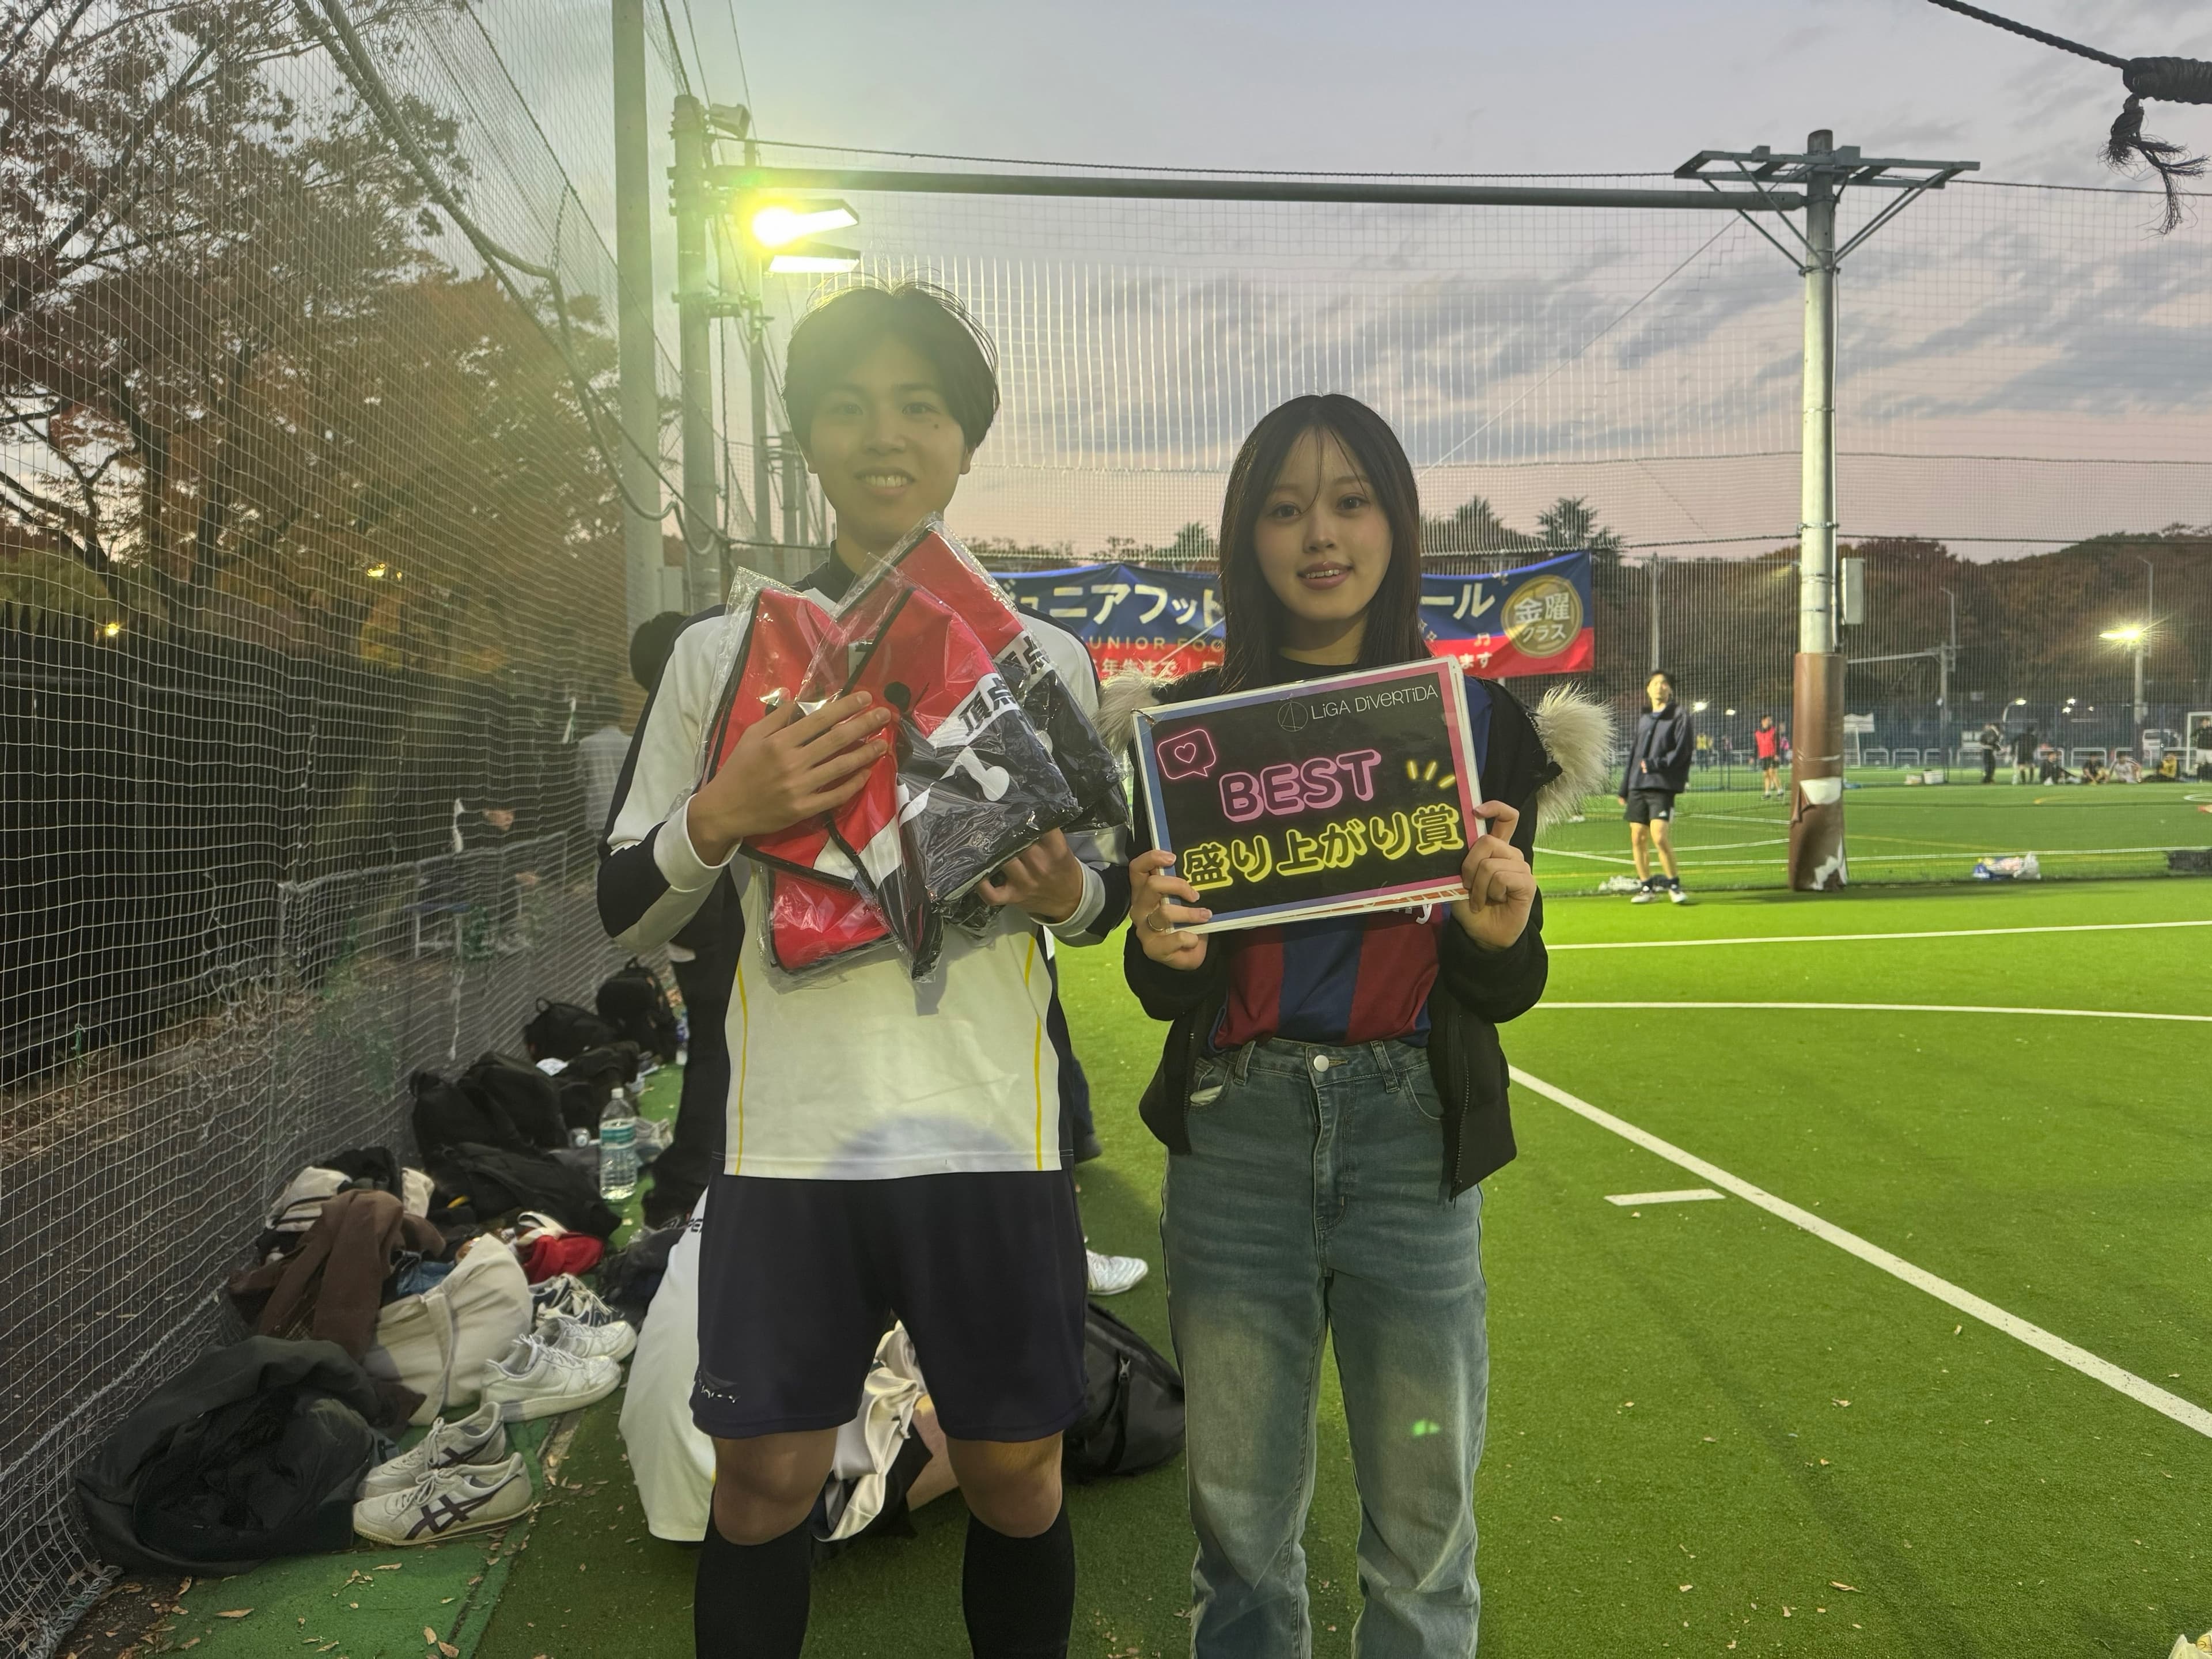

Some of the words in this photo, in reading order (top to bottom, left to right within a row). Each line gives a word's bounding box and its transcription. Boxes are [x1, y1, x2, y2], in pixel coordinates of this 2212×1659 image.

[1003, 578, 1225, 627] ュニアフット
[1514, 592, 1570, 623] 金曜
[1081, 636, 1165, 650] UNIOR
[1522, 624, 1566, 642] クラス
[958, 677, 1017, 736] 頂点
[1219, 749, 1381, 822] BEST
[1183, 803, 1464, 891] 盛り上がり賞
